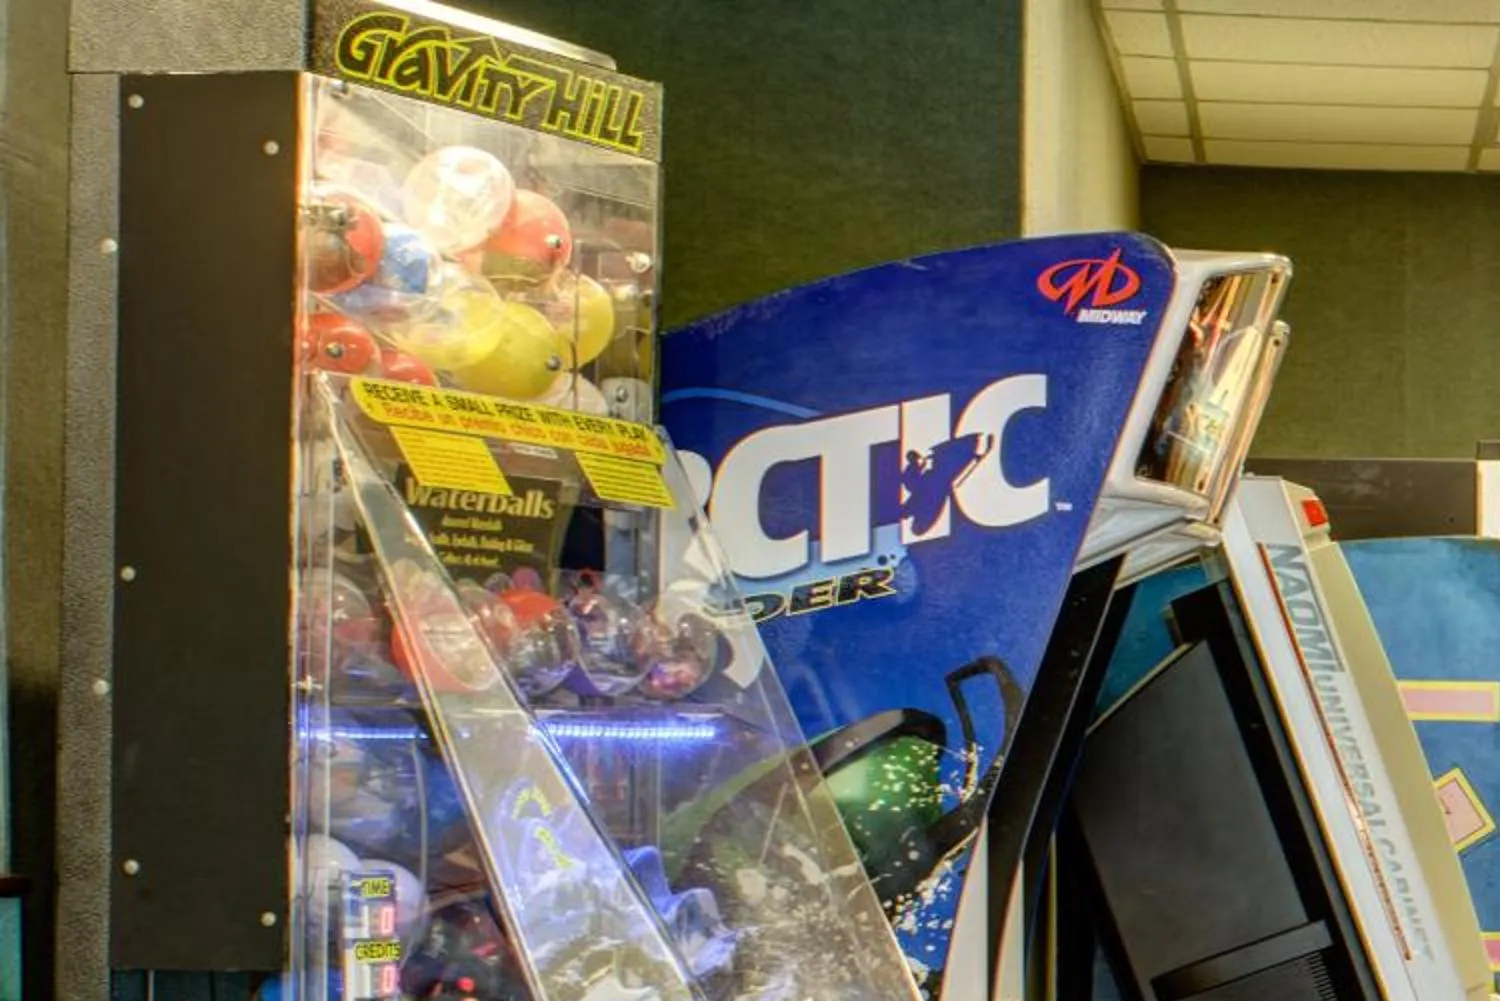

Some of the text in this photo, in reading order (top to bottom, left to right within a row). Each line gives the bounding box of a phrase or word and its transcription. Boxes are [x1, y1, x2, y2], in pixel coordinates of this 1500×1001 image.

[1077, 308, 1148, 325] MIDWAY
[444, 394, 496, 417] SMALL
[494, 402, 536, 422] PRIZE
[660, 373, 1051, 588] RCTIC
[361, 879, 390, 896] TIME
[355, 943, 401, 961] CREDITS
